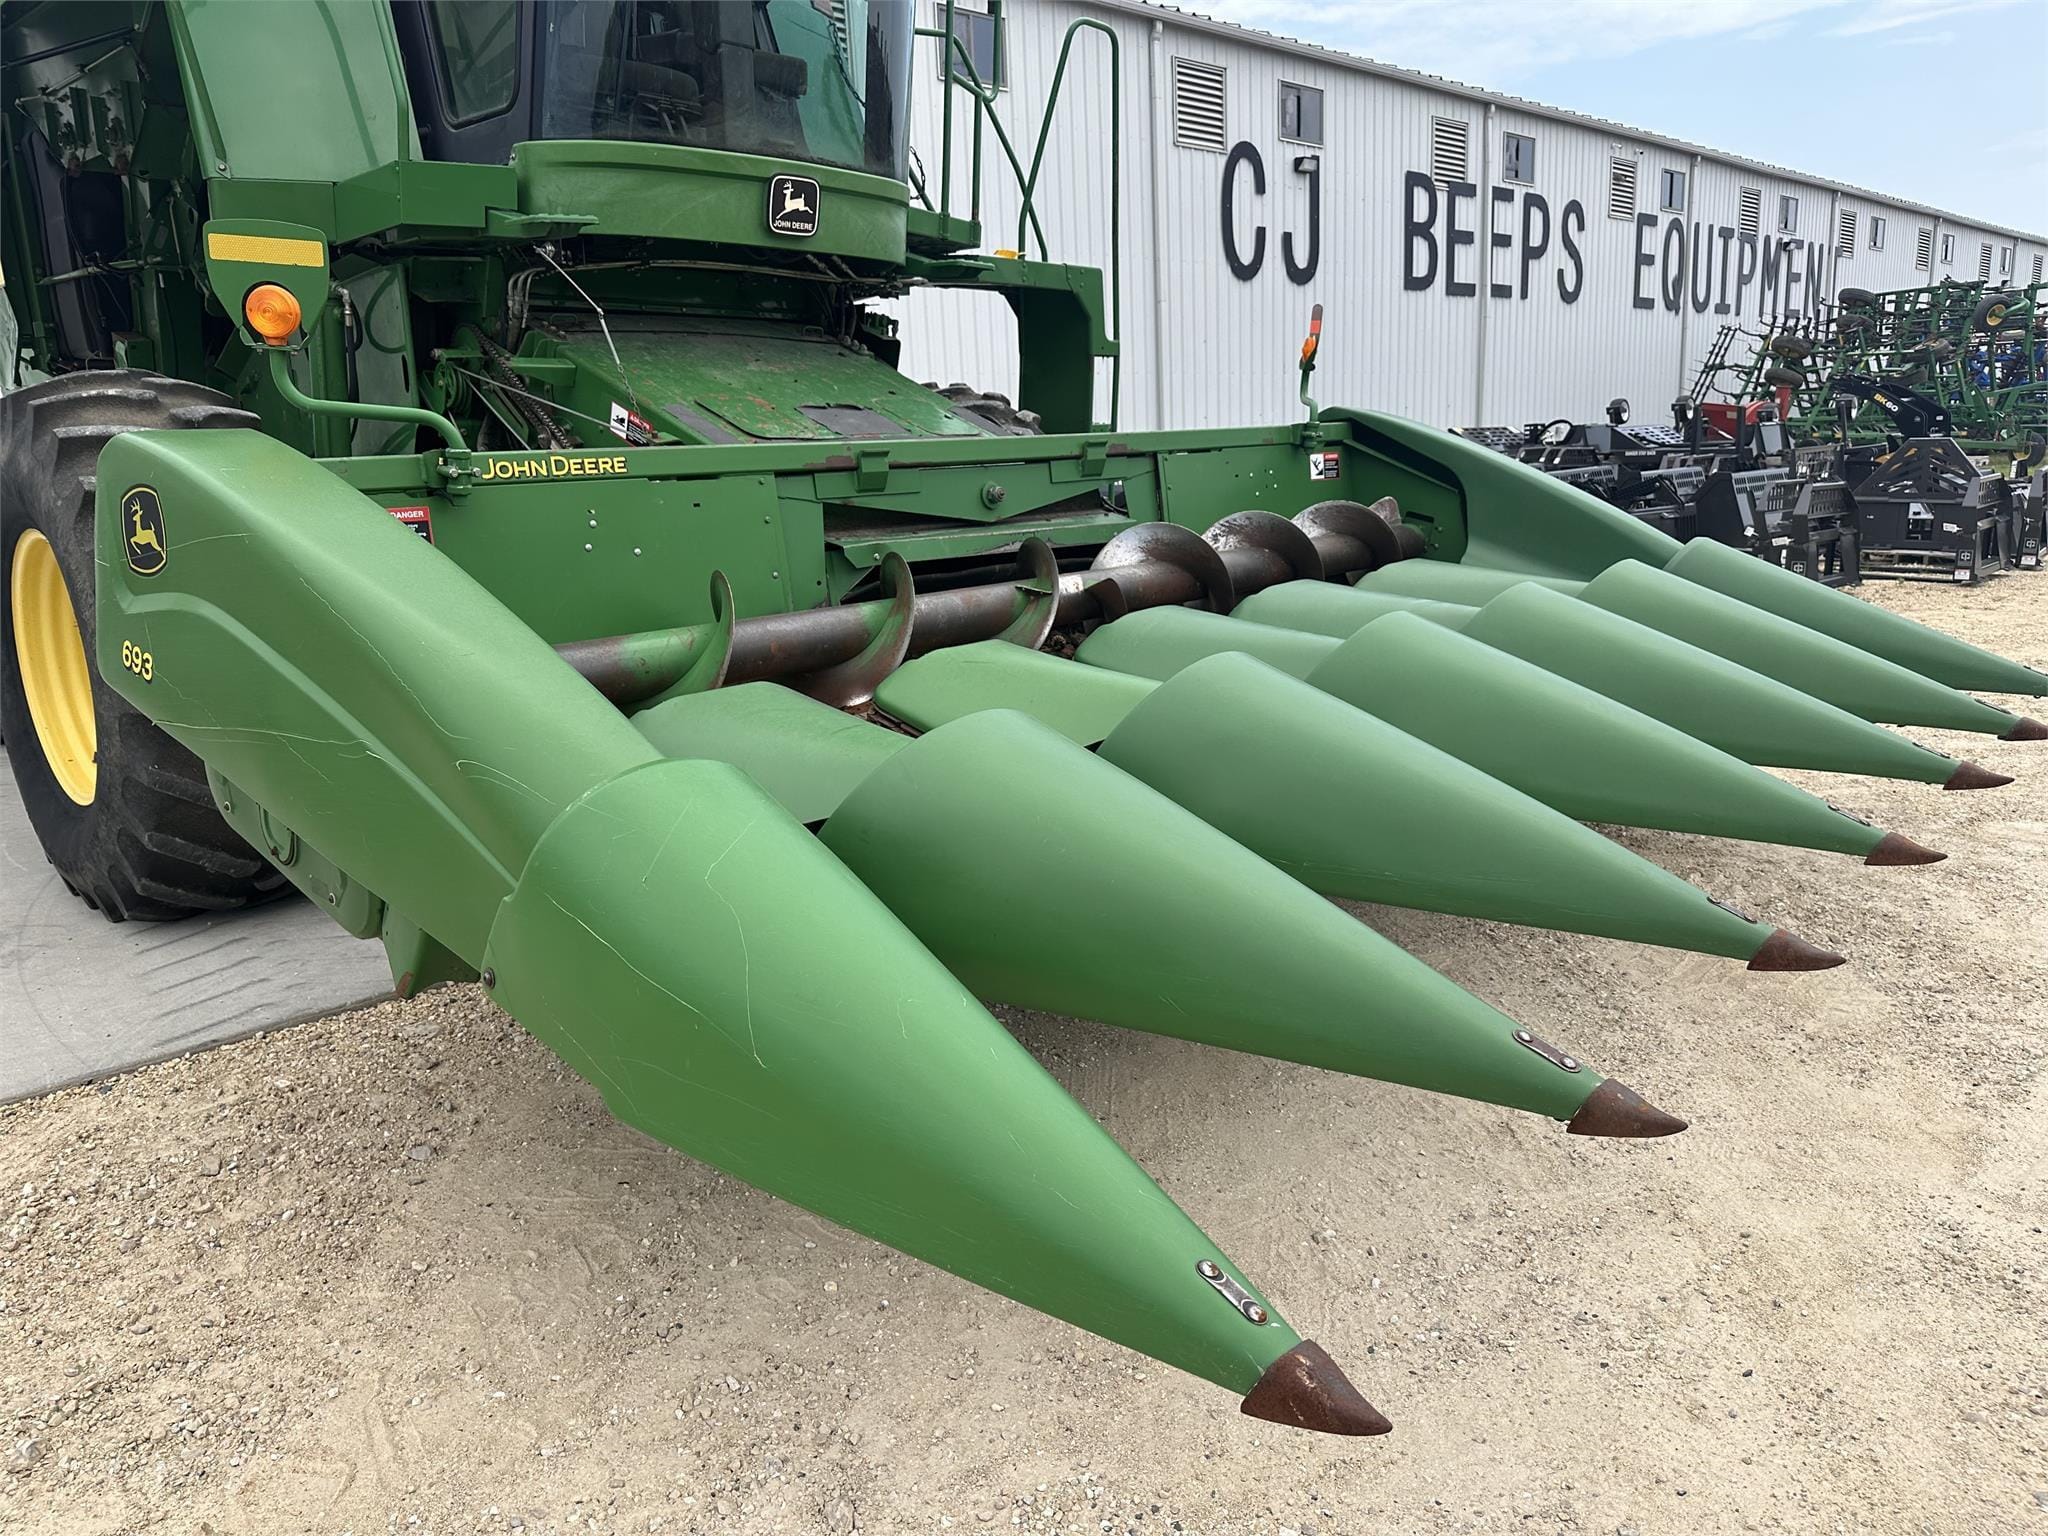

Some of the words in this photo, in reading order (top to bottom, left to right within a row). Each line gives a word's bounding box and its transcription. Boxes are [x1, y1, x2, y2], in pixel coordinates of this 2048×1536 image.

[773, 219, 791, 229] JOHN
[791, 221, 813, 231] DEERE
[1221, 141, 1320, 285] CJ
[1403, 170, 1585, 304] BEEPS
[481, 457, 548, 480] JOHN
[550, 455, 628, 476] DEERE
[122, 639, 153, 681] 693
